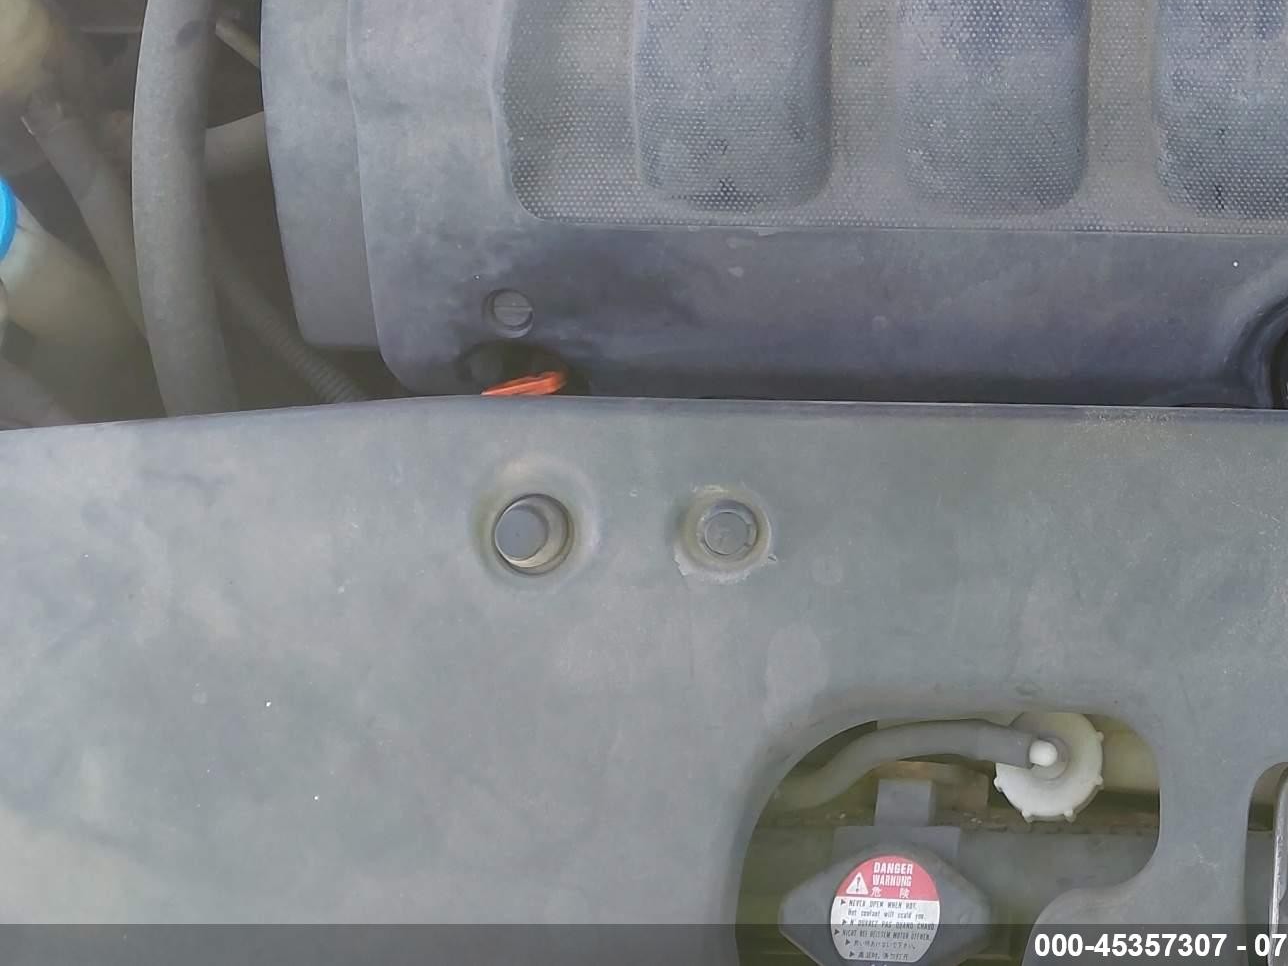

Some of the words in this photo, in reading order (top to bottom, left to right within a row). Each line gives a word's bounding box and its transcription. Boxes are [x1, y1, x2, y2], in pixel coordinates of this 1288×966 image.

[873, 862, 914, 875] DANGER
[872, 874, 912, 887] WARNUNG
[848, 899, 866, 907] NEVER
[869, 900, 884, 908] OPEN
[887, 901, 903, 909] WHEN
